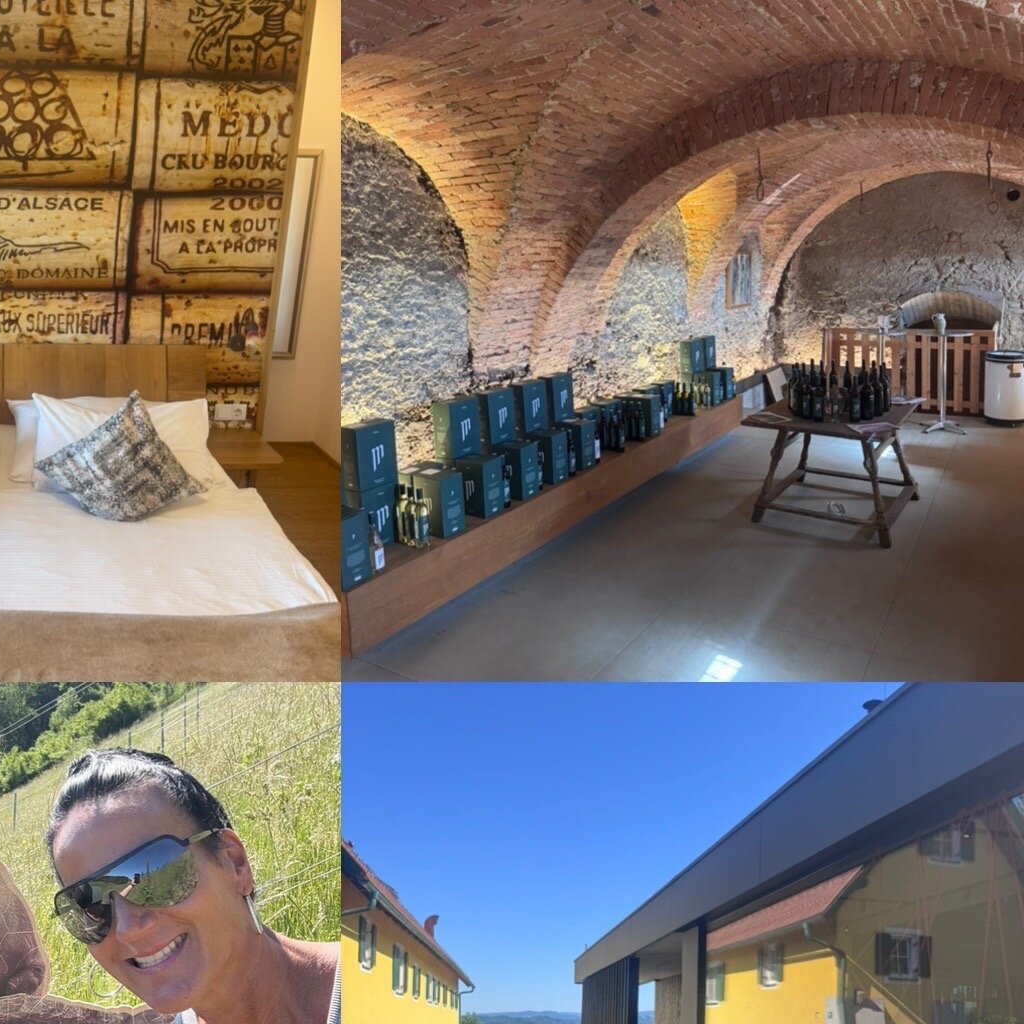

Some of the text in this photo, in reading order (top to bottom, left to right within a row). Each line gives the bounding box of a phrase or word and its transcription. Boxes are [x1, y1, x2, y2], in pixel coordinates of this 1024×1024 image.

[212, 177, 283, 190] 2002
[163, 219, 195, 234] MIS
[203, 218, 225, 233] EN
[178, 241, 190, 254] A
